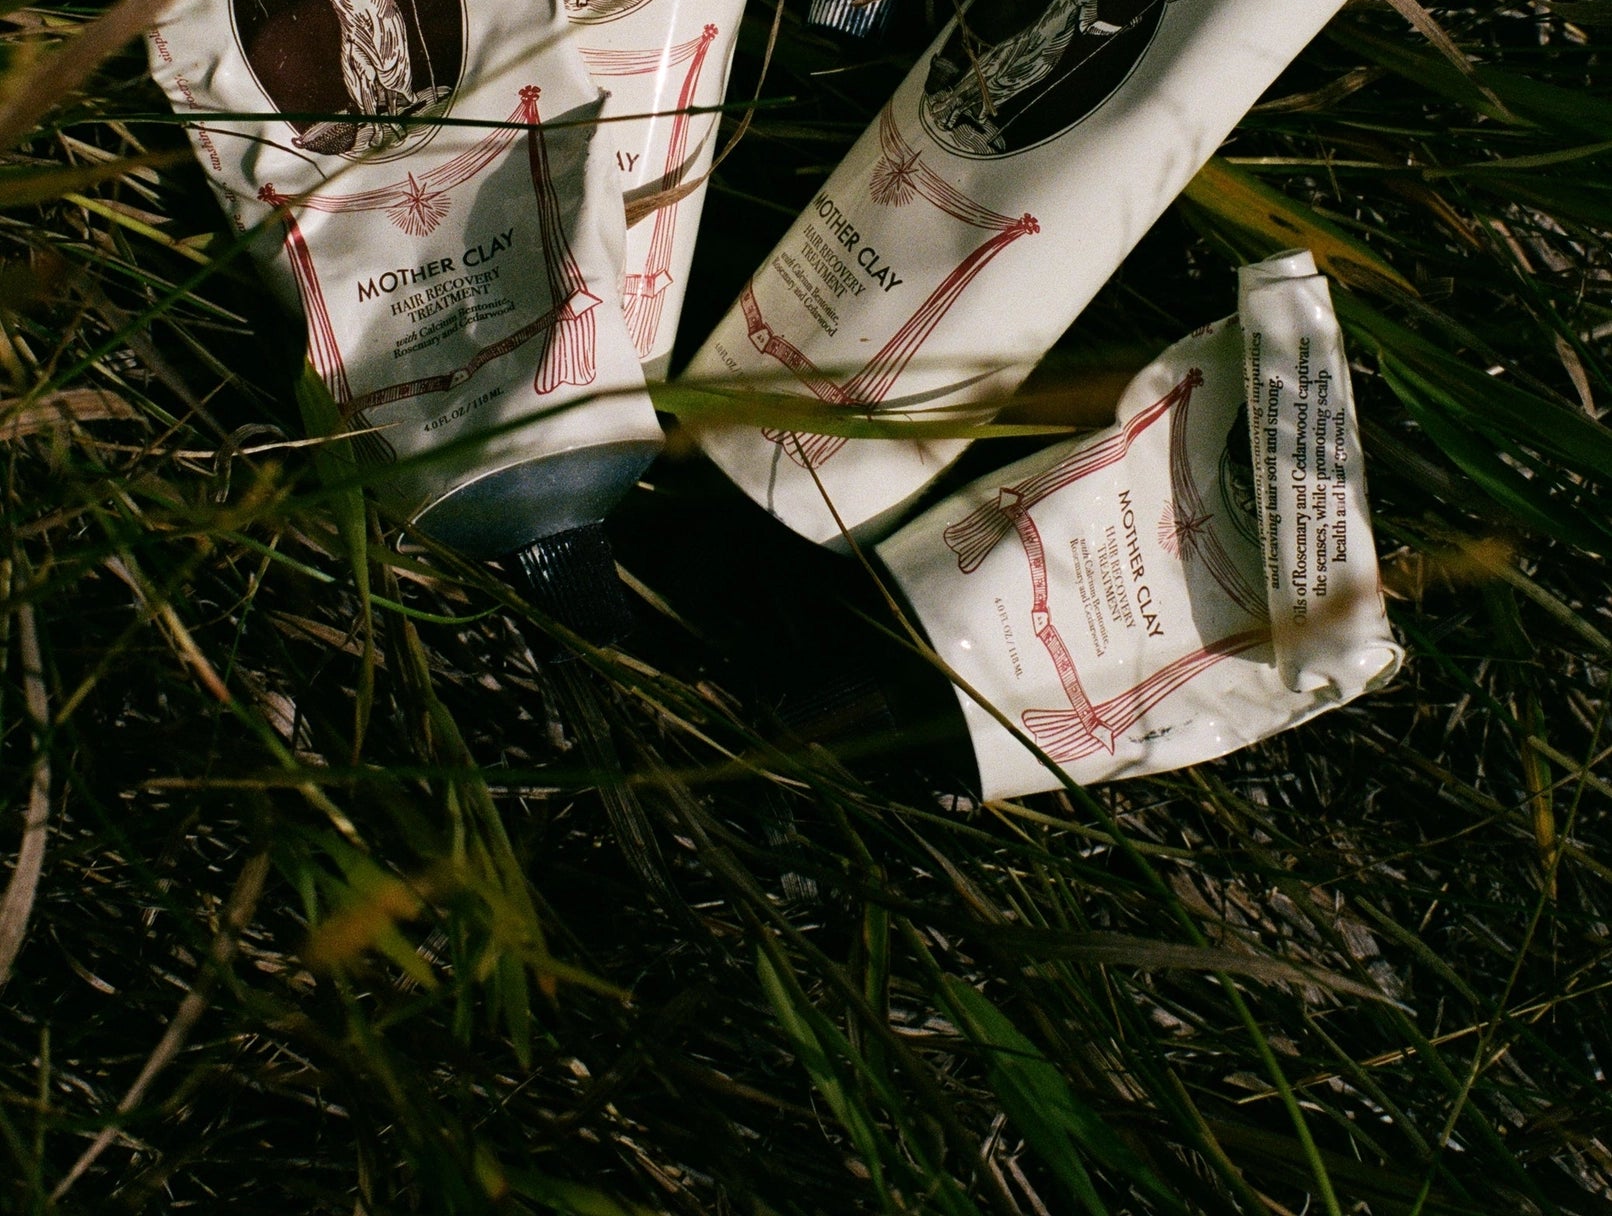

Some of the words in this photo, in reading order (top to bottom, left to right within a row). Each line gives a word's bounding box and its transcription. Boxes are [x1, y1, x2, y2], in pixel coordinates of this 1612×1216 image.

[803, 224, 823, 250] HAIR
[820, 243, 866, 296] RECOVERY
[813, 191, 860, 253] MOTHER
[857, 247, 903, 293] CLAY
[357, 257, 455, 303] MOTHER
[463, 228, 514, 267] CLAY
[801, 242, 848, 298] TREATMENT
[391, 293, 424, 316] HAIR
[425, 266, 500, 301] RECOVERY
[408, 283, 491, 323] TREATMENT
[393, 335, 440, 359] Rosemary
[442, 325, 458, 339] and
[396, 331, 418, 347] with
[419, 315, 458, 337] Calcium
[1295, 336, 1313, 400] captivate
[1314, 370, 1332, 405] scalp
[451, 407, 465, 419] OZ
[1268, 376, 1283, 425] strong.
[1264, 428, 1278, 453] and
[1292, 403, 1308, 481] Cedarwood
[1313, 408, 1331, 480] promoting
[1332, 408, 1348, 462] growth.
[1264, 456, 1277, 481] soft
[1331, 460, 1346, 489] hair
[1266, 484, 1277, 511] hair
[1292, 485, 1306, 509] and
[1312, 484, 1327, 521] while
[1332, 492, 1345, 516] and
[1105, 525, 1118, 558] HAIR
[1266, 513, 1281, 560] leaving
[1292, 513, 1311, 580] Rosemary
[1317, 523, 1329, 572] senses,
[1332, 520, 1346, 562] health
[1097, 544, 1122, 622] TREATMENT
[1118, 489, 1144, 582] MOTHER
[1137, 585, 1164, 637] CLAY
[1268, 564, 1279, 589] and
[1111, 559, 1136, 628] RECOVERY
[1293, 580, 1306, 596] of
[1312, 578, 1326, 596] the
